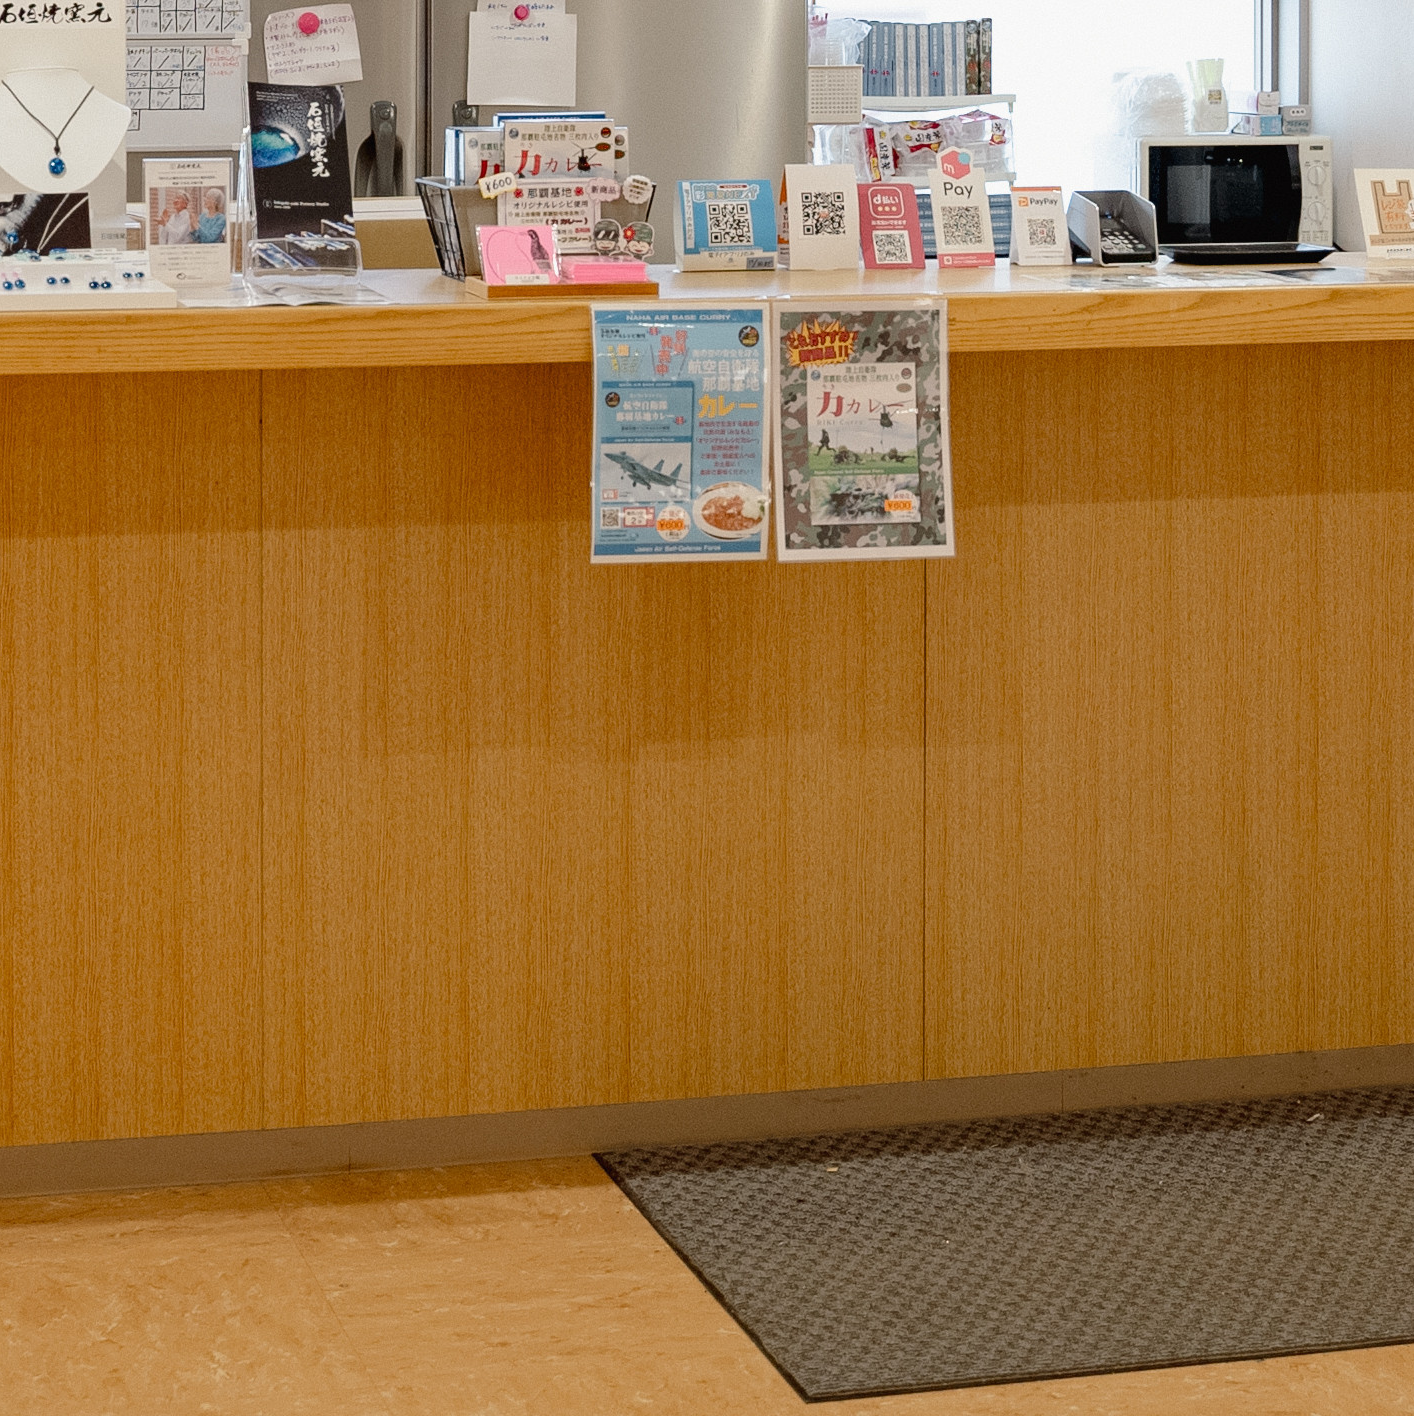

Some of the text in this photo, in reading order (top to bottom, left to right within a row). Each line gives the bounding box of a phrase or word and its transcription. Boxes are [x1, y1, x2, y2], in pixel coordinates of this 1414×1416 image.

[307, 101, 330, 177] 石垣焼窯元
[486, 176, 513, 193] ¥600
[591, 185, 617, 194] 新商品
[528, 187, 572, 198] 那覇基地
[943, 182, 973, 199] Pay
[873, 194, 898, 204] d払い
[1029, 197, 1058, 205] PayPay
[514, 200, 588, 210] オリジナルレシピ使用
[698, 394, 758, 418] カレー
